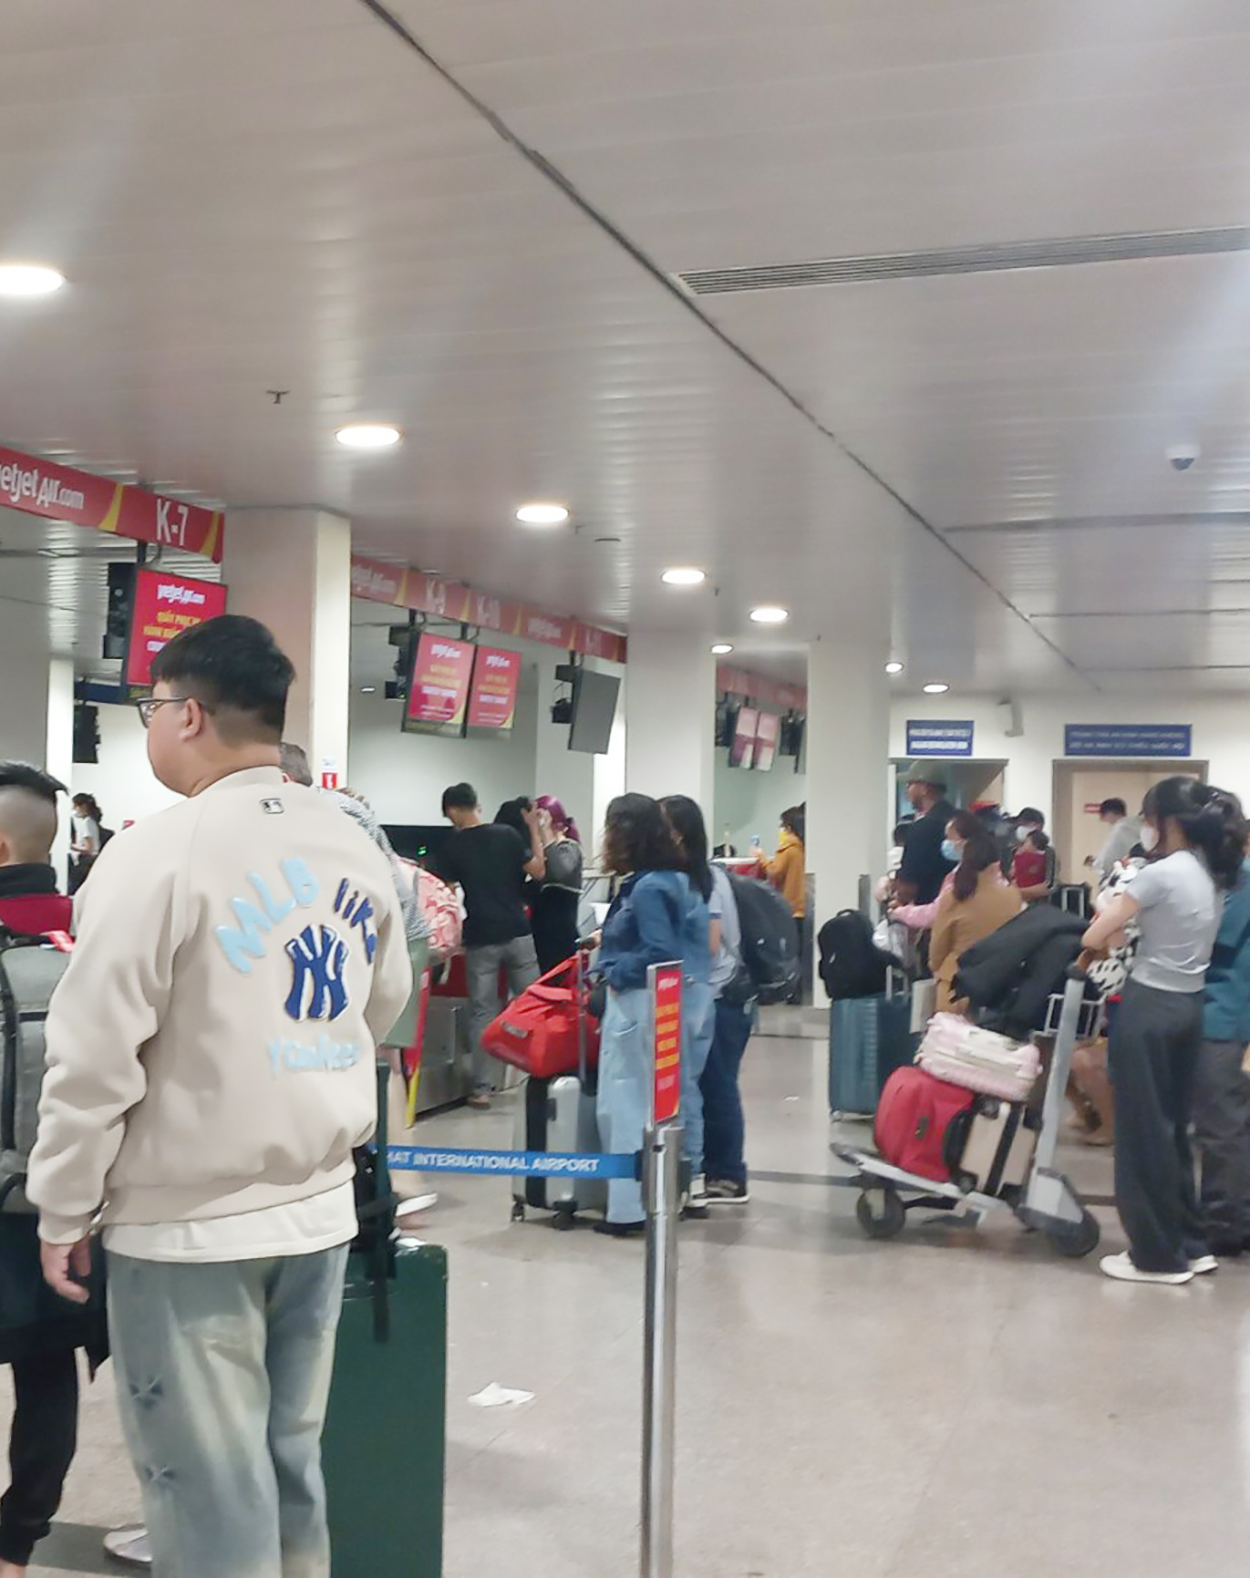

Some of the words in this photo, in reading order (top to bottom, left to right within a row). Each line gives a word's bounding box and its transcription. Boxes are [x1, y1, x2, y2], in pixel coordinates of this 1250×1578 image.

[156, 498, 189, 546] K-7
[214, 856, 320, 975] MLB
[412, 1152, 530, 1170] INTERNATIONAL
[531, 1157, 600, 1173] AIRPORT
